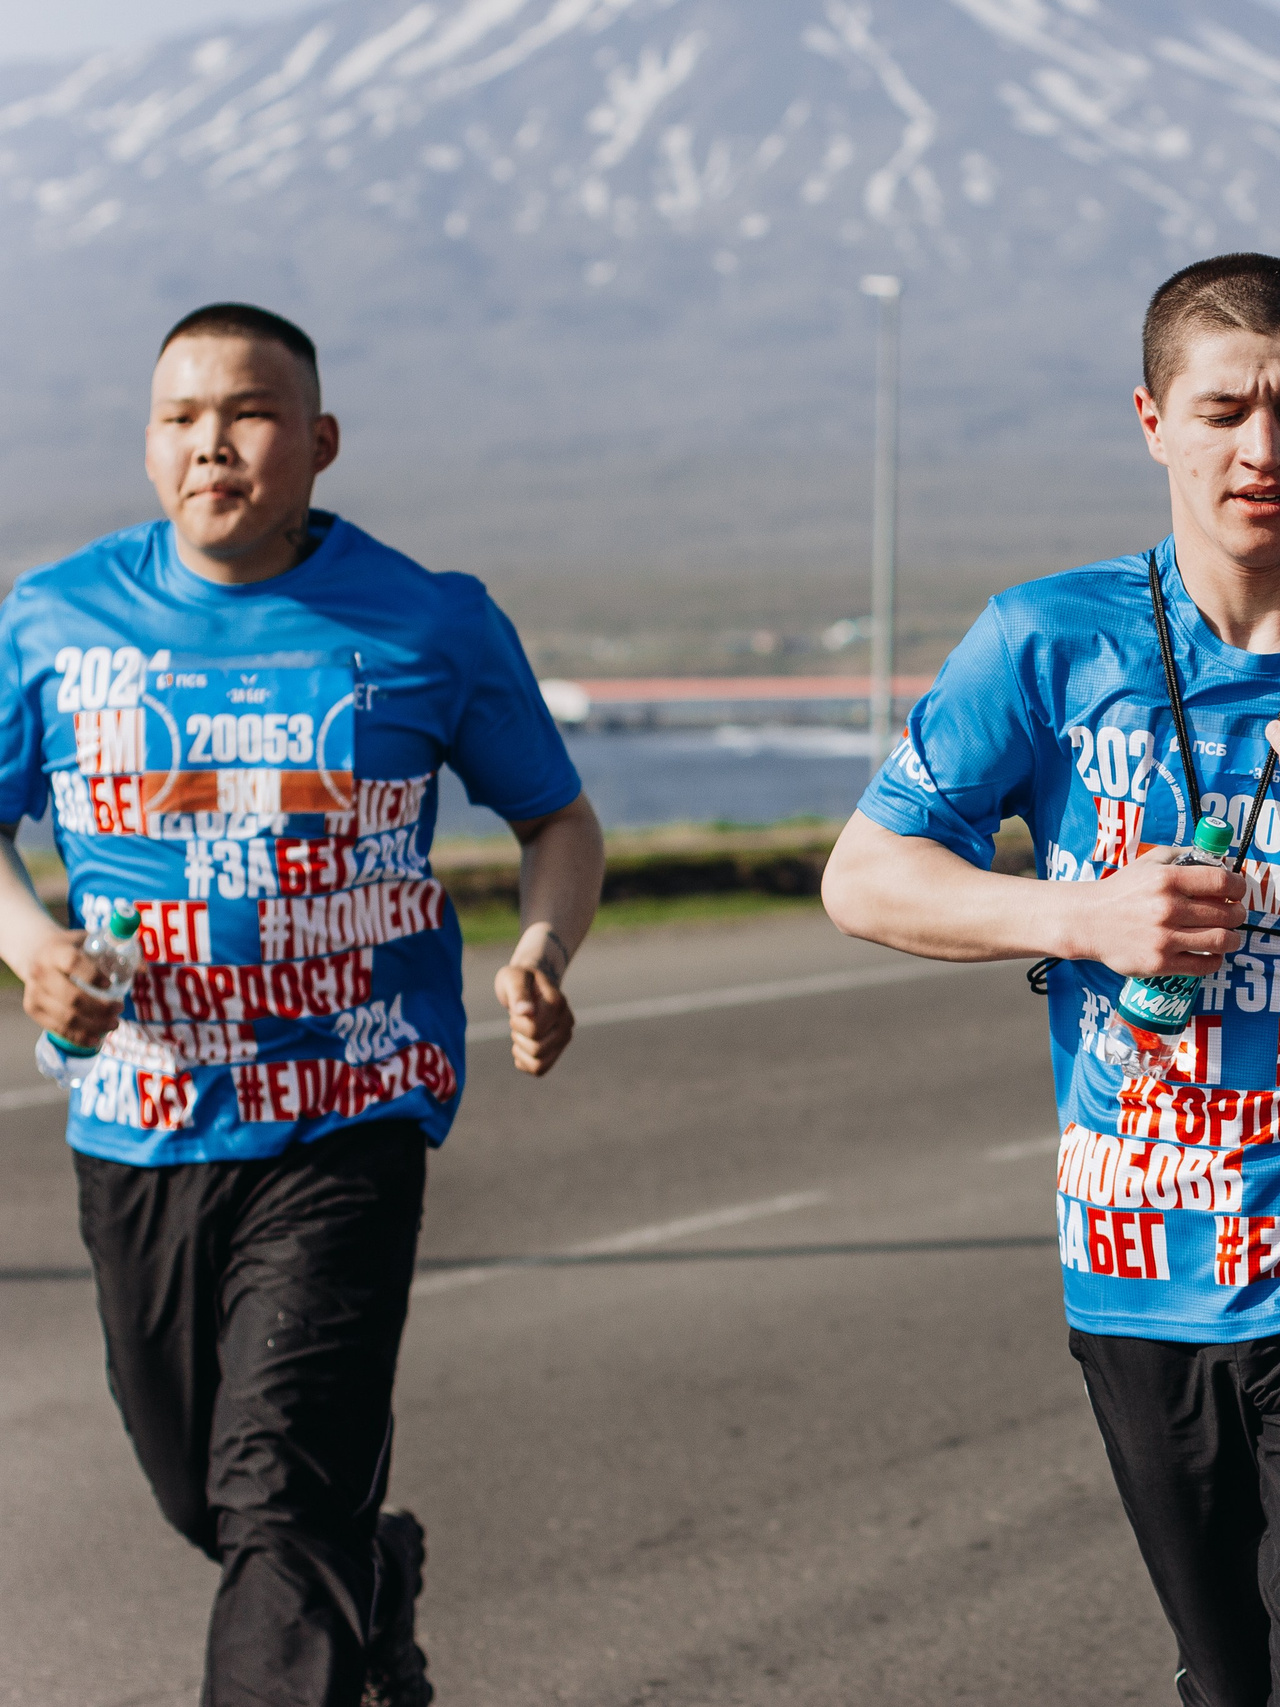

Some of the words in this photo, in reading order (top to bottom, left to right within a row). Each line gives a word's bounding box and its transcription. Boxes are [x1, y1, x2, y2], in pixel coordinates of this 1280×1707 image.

[186, 712, 314, 763] 20053
[1192, 739, 1228, 757] ПСБ
[258, 878, 446, 961] #МОМЕНТ
[131, 947, 373, 1022] #ГОРДОСТЬ
[1131, 988, 1192, 1020] ЛАЙН
